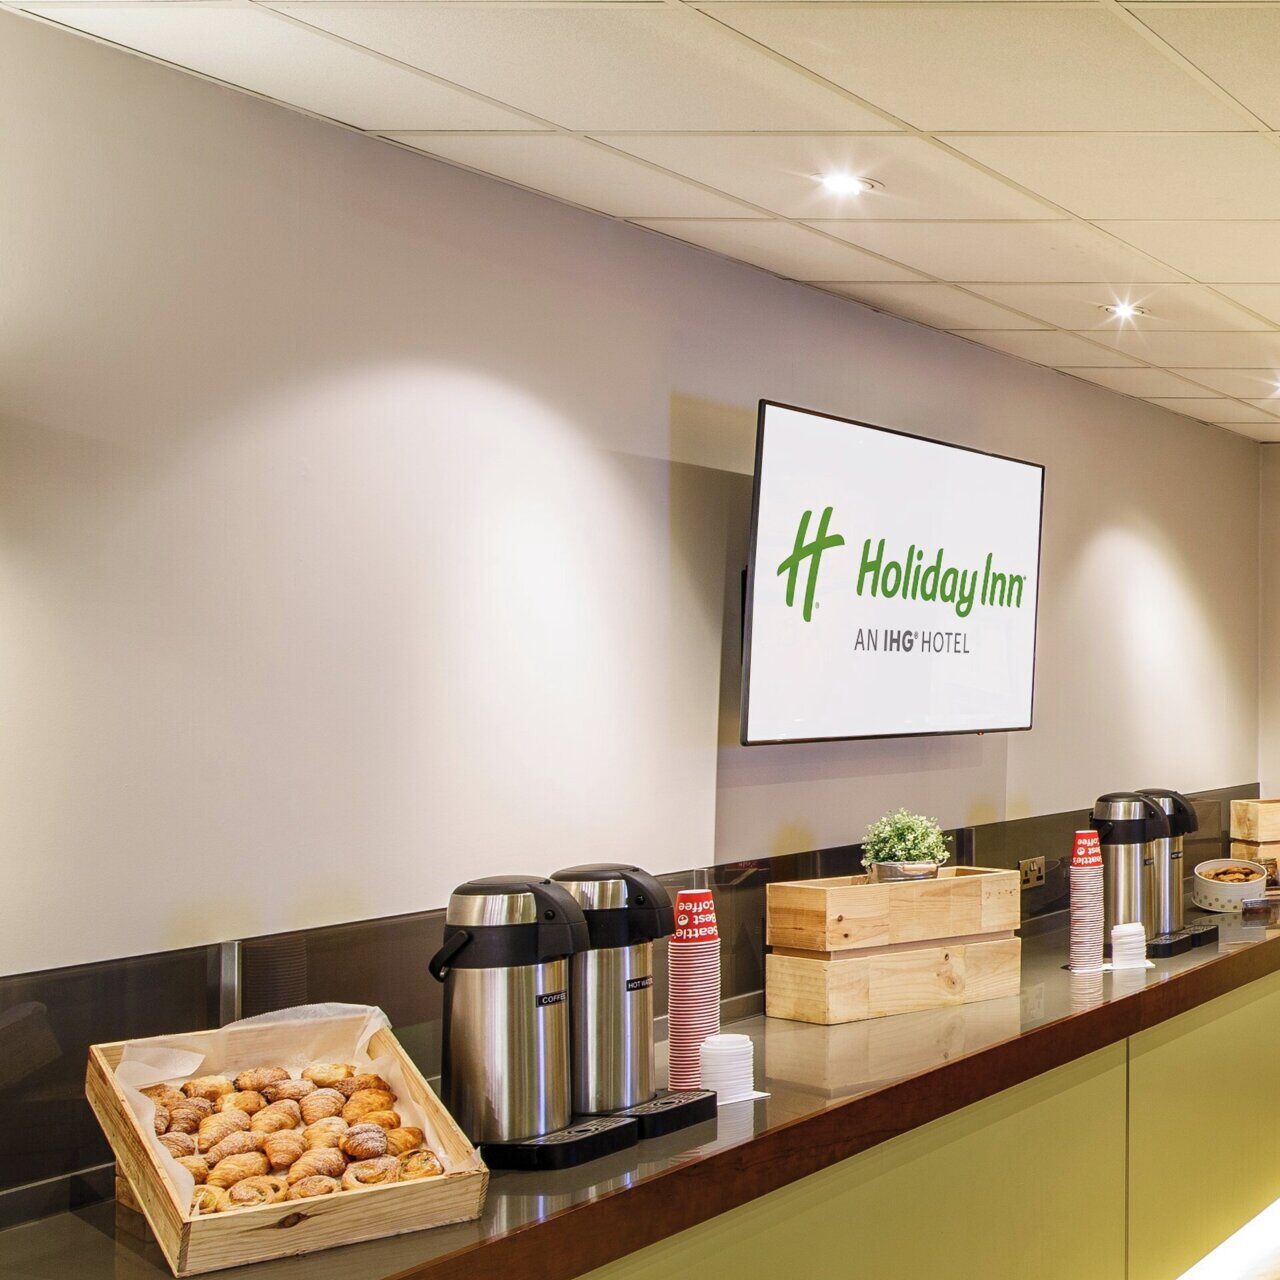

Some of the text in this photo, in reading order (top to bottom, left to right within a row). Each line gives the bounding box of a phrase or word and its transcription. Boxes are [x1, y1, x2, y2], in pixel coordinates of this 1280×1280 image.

[856, 538, 978, 617] Holiday
[854, 628, 878, 651] AN
[921, 631, 970, 653] HOTEL
[678, 900, 715, 913] Coffee
[692, 912, 717, 925] Best
[628, 980, 641, 989] HOT
